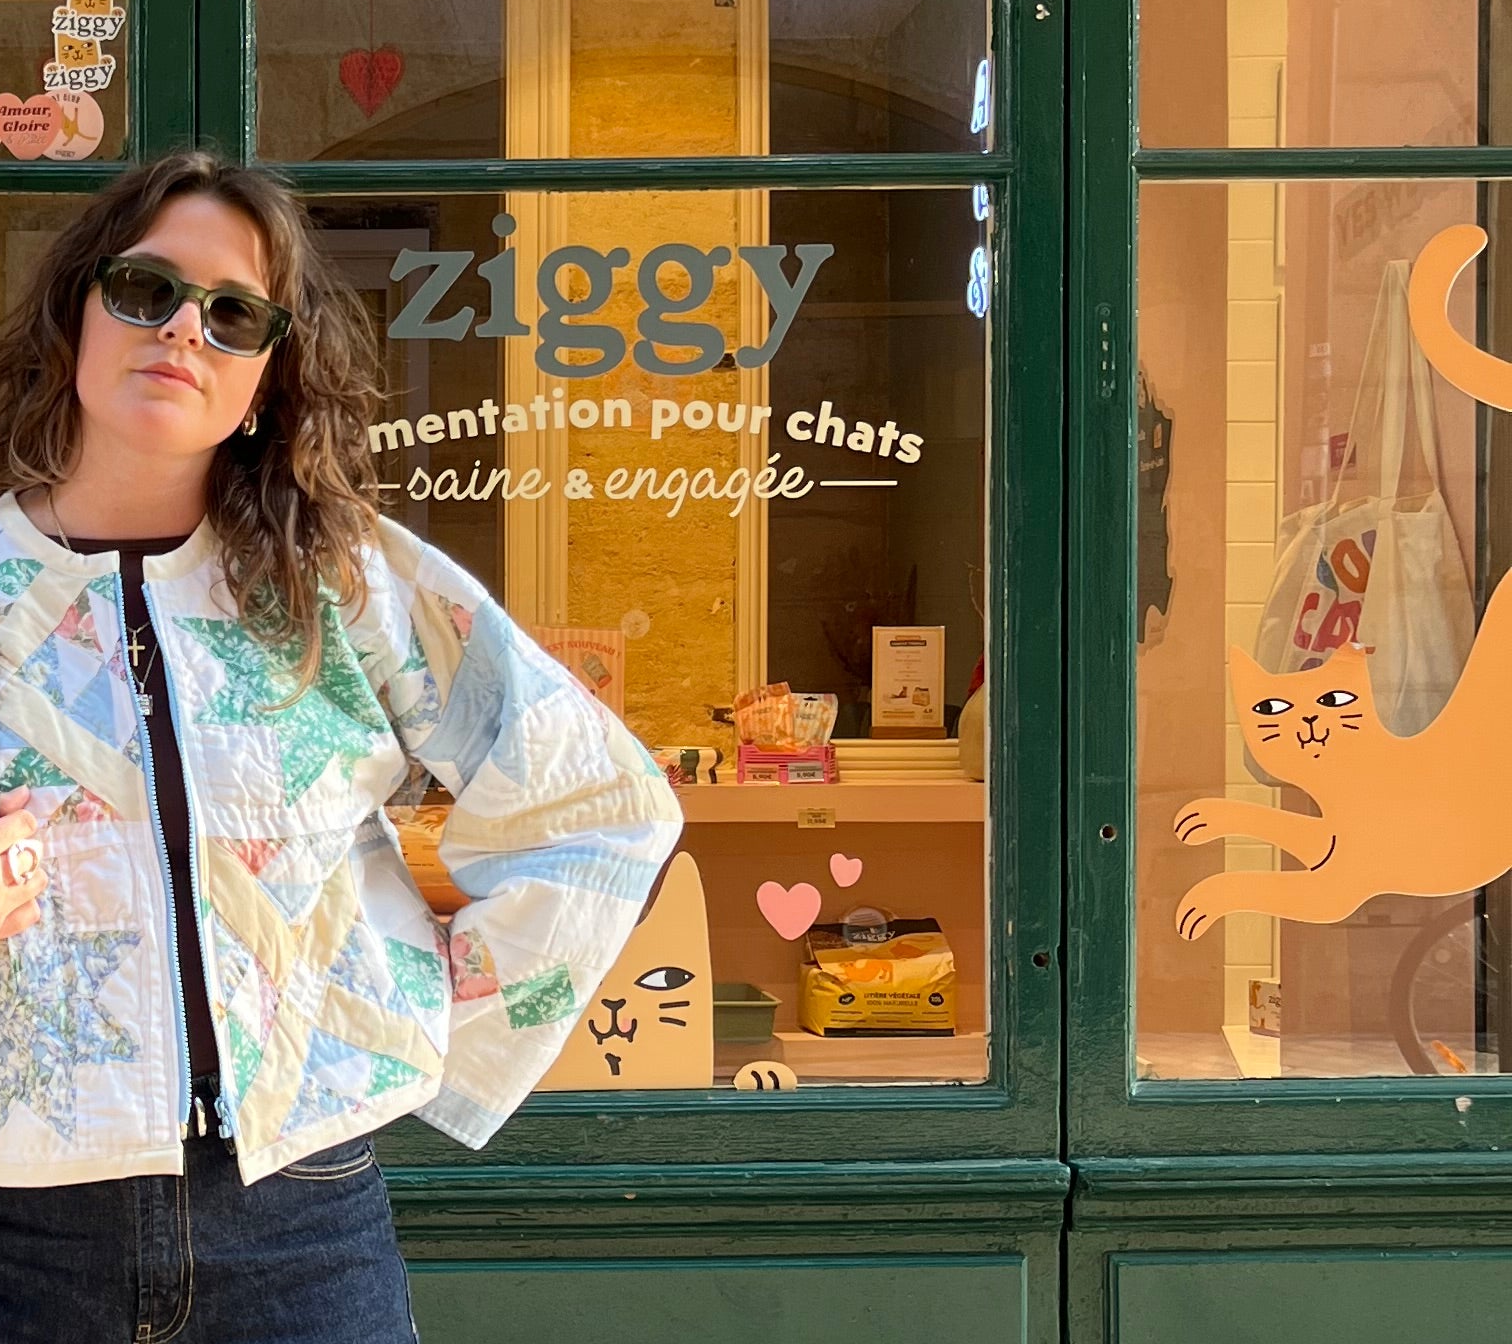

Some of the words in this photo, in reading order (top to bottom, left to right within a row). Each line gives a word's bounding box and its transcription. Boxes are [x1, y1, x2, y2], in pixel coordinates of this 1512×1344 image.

[54, 11, 124, 38] ziggy
[45, 63, 113, 91] ziggy
[2, 120, 51, 132] Gloire
[387, 213, 835, 377] ziggy
[367, 387, 633, 454] mentation
[651, 397, 773, 441] pour
[784, 400, 925, 465] chats
[406, 458, 552, 502] saine
[563, 468, 595, 499] &
[603, 452, 815, 519] engagée
[567, 640, 616, 656] NOUVEAU
[851, 930, 896, 942] ziggy
